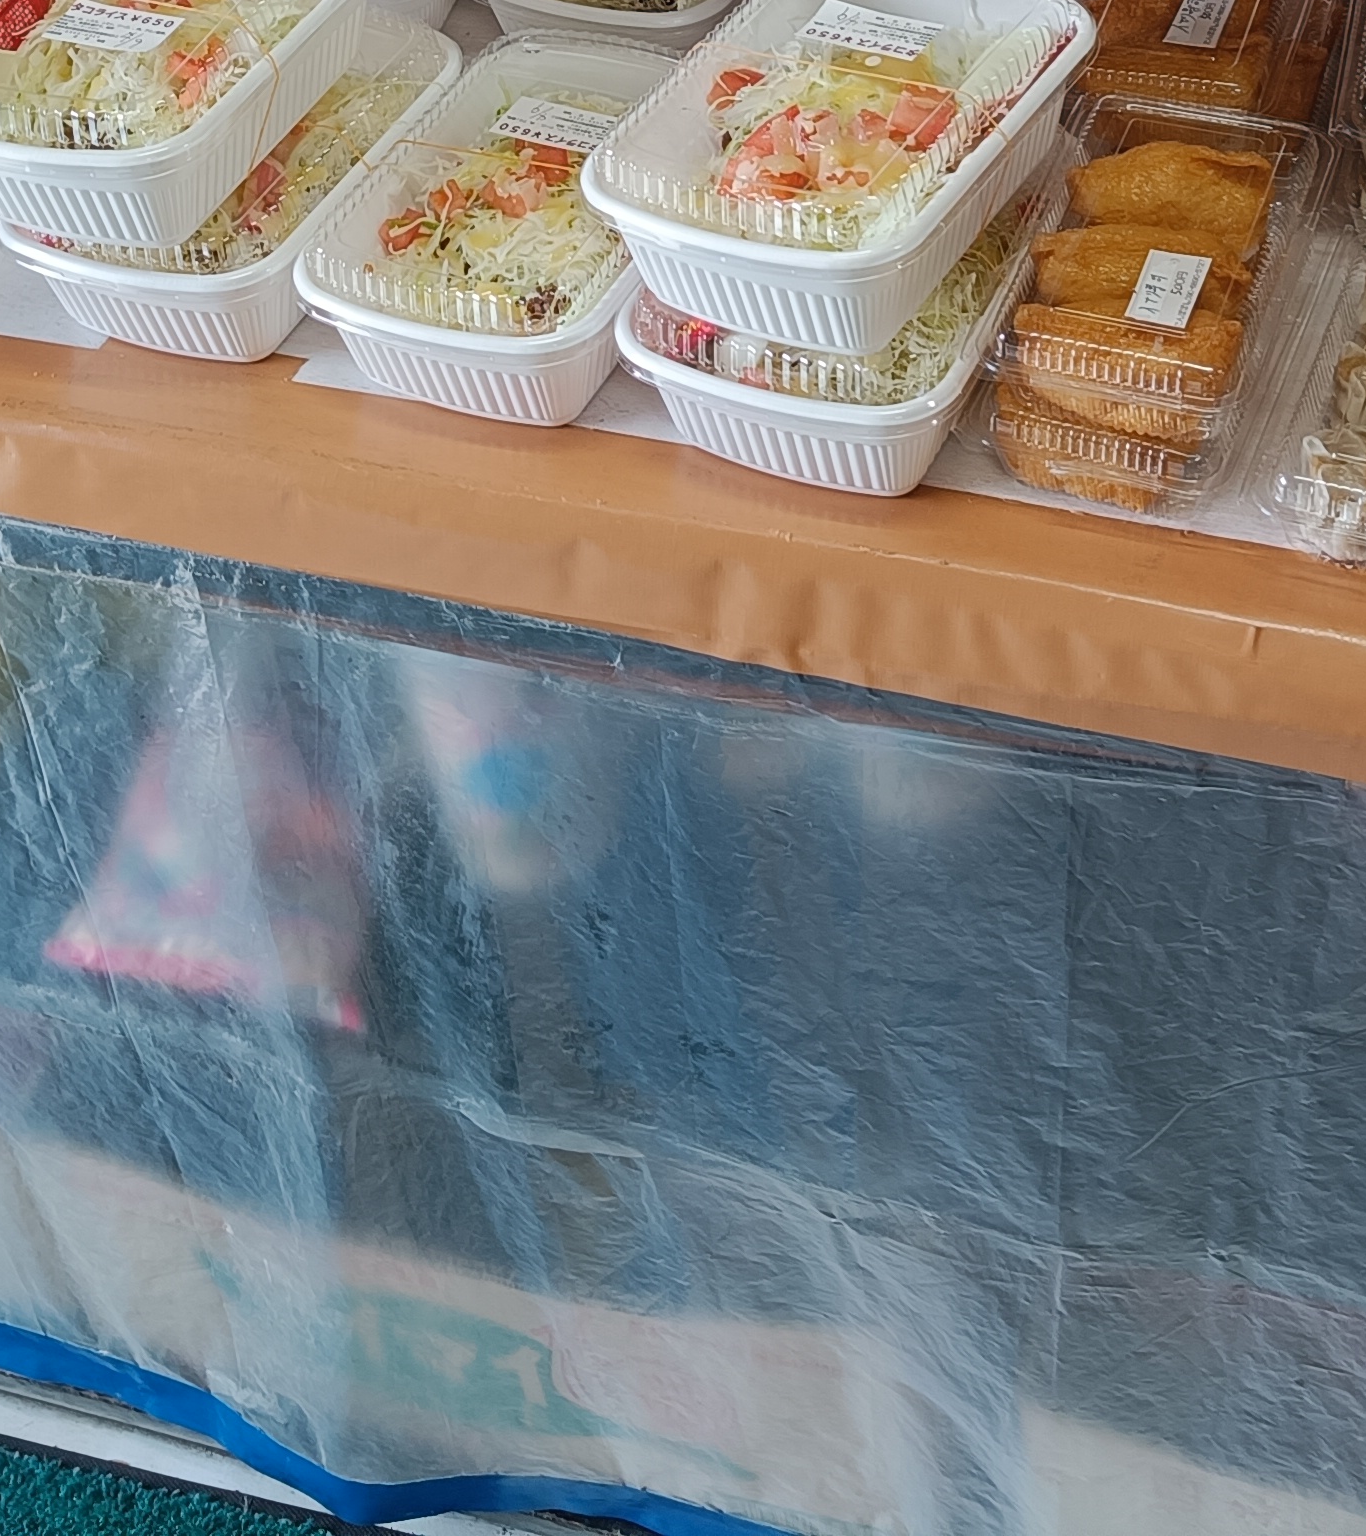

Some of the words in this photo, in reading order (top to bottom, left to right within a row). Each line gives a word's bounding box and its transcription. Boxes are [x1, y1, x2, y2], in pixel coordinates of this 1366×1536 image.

[71, 3, 128, 20] タコライス
[130, 14, 175, 28] ¥650
[806, 28, 852, 43] ¥650
[856, 37, 918, 57] タコライス
[499, 122, 542, 138] ¥650
[1170, 270, 1189, 296] 500円
